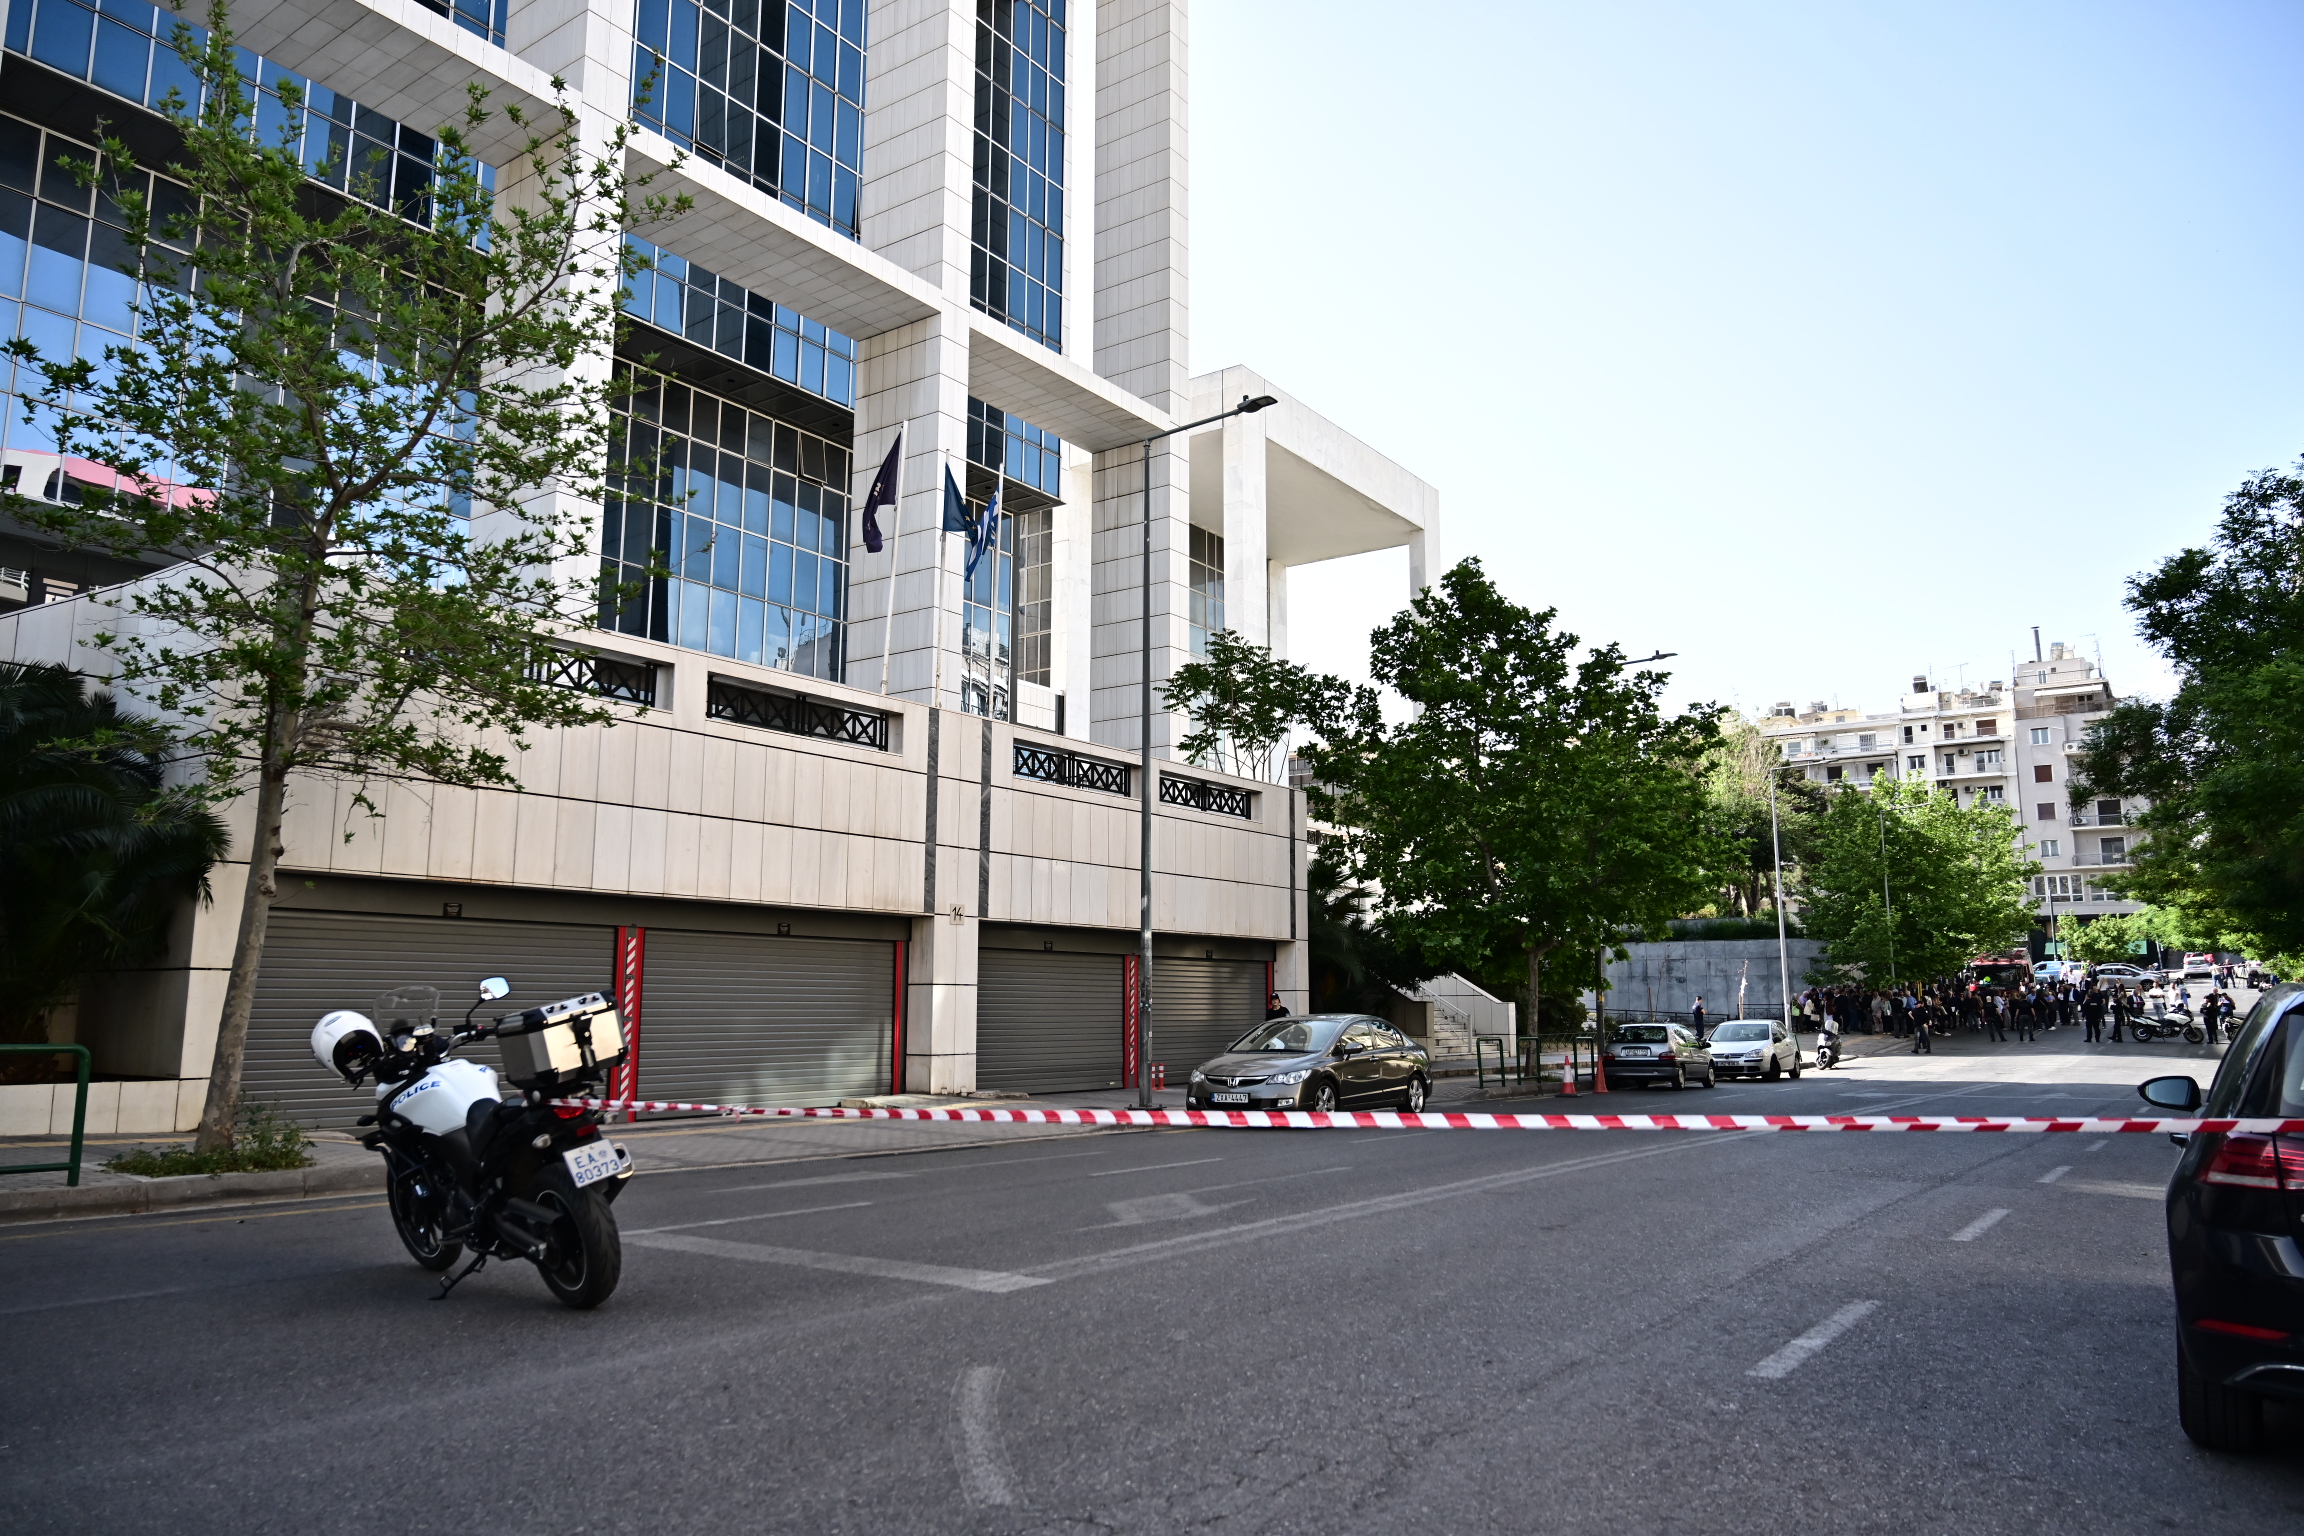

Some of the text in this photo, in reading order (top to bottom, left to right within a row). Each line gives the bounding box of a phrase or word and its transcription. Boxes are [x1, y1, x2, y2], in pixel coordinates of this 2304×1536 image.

[951, 906, 964, 921] 14
[391, 1081, 441, 1111] POLICE
[575, 1159, 620, 1183] 80373
